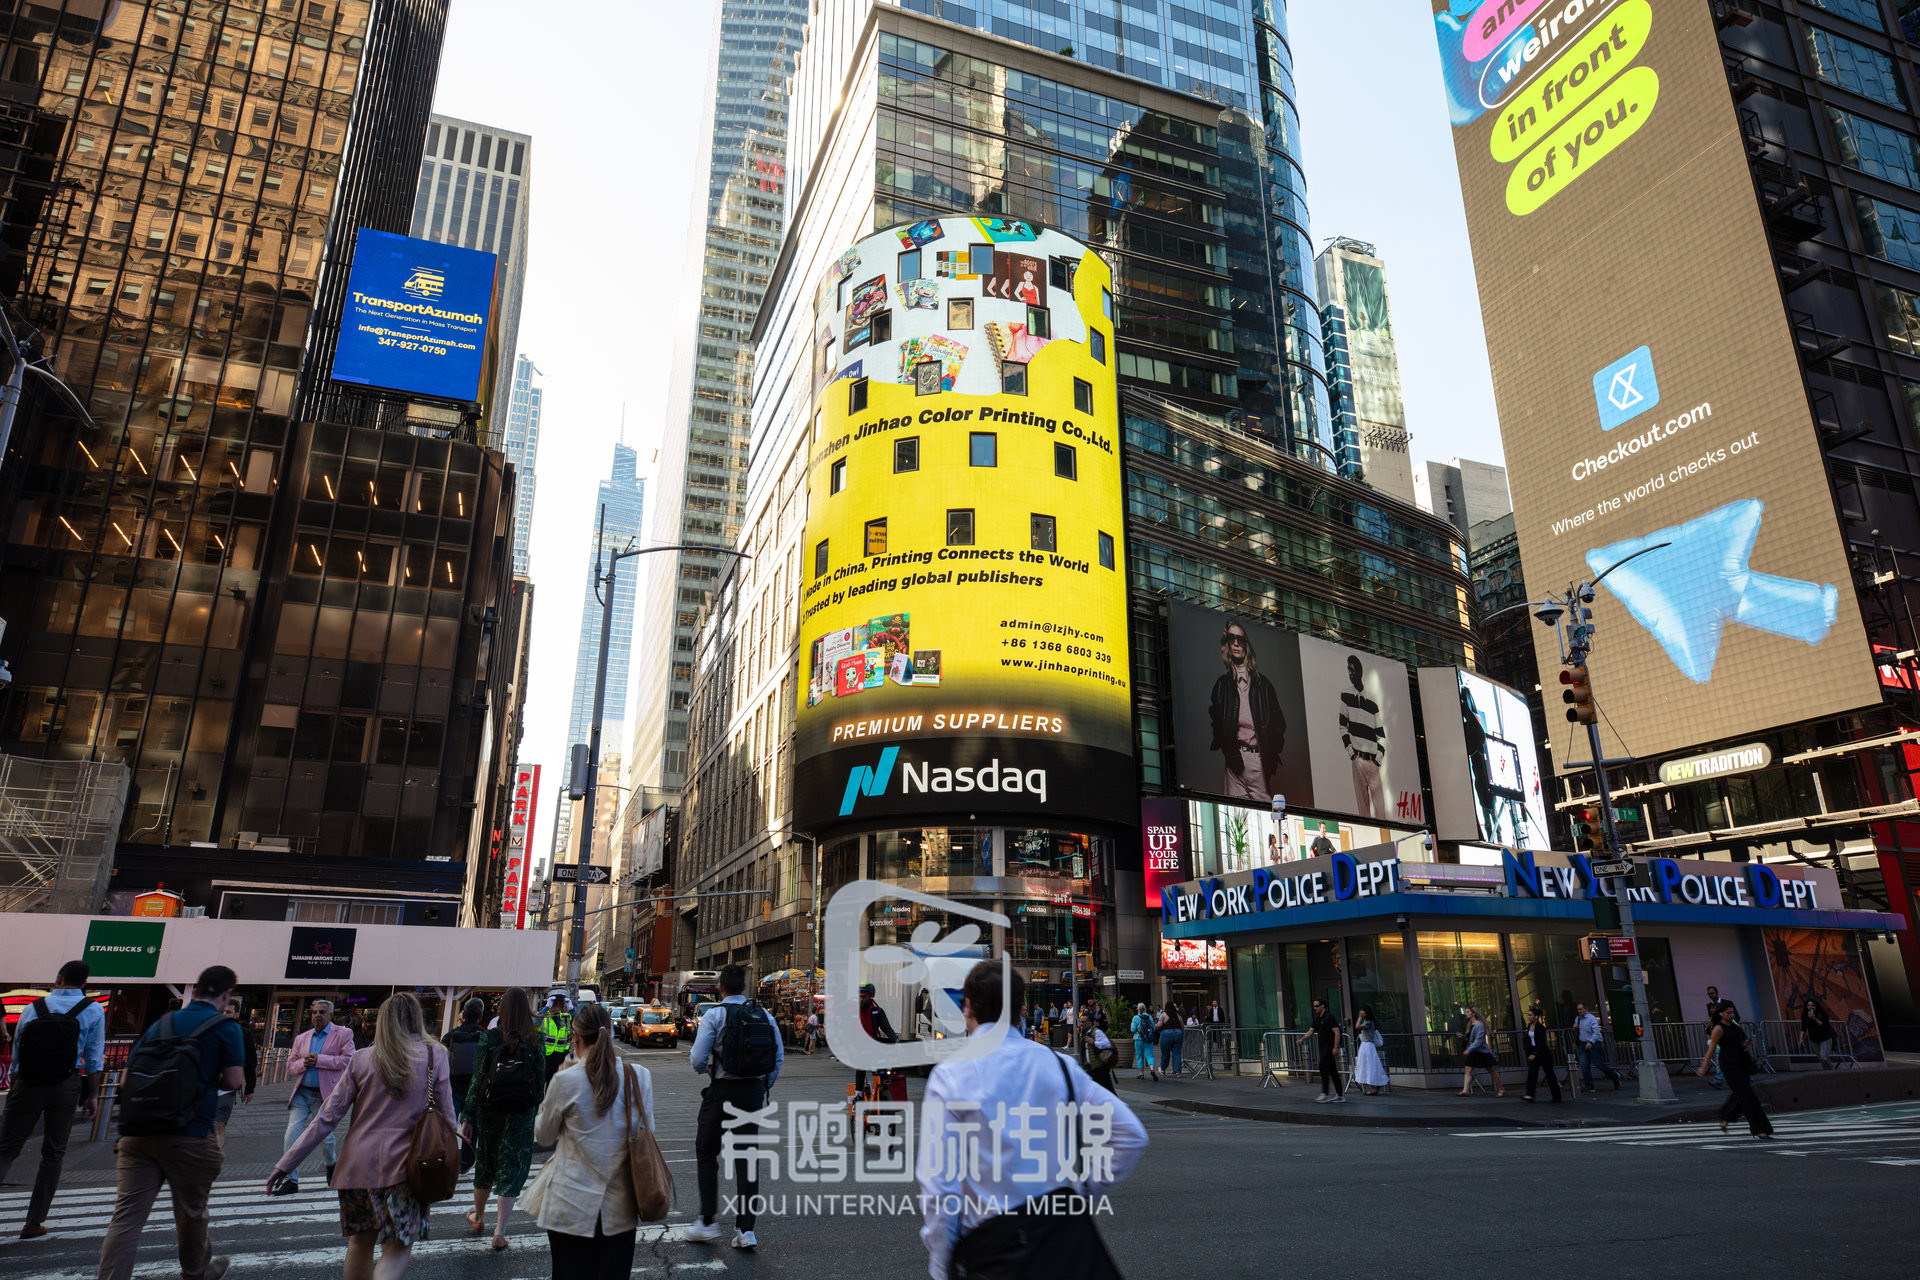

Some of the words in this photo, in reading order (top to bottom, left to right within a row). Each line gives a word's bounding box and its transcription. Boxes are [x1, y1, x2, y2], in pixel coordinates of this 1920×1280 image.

[1482, 0, 1524, 40] an
[1507, 106, 1537, 143] in
[1542, 22, 1628, 112] front
[1527, 146, 1556, 192] of
[1564, 98, 1639, 170] you.
[352, 292, 482, 325] TransportAzumah
[368, 309, 384, 317] Next
[384, 312, 421, 323] Generation
[428, 320, 446, 328] Mass
[446, 322, 477, 333] Transport
[378, 337, 447, 356] 347-927-0750
[854, 415, 912, 441] Jinhao
[918, 407, 973, 425] Color
[979, 407, 1057, 433] Printing
[1061, 420, 1113, 455] Co.,Ltd.
[1571, 401, 1713, 481] Checkout.com
[1551, 507, 1595, 536] Where
[1597, 496, 1621, 516] the
[1623, 473, 1665, 503] world
[1668, 448, 1727, 483] checks
[1730, 431, 1760, 455] out
[823, 575, 832, 587] in
[833, 563, 868, 582] China,
[871, 550, 933, 569] Printing
[937, 548, 1014, 560] Connects
[1019, 550, 1044, 564] the
[1048, 554, 1089, 574] World
[832, 591, 846, 605] by
[848, 578, 897, 598] leading
[901, 570, 953, 590] global
[956, 570, 1043, 587] publishers
[1000, 619, 1104, 643] admin@lzjhy.com
[1001, 638, 1027, 648] +86
[1032, 640, 1062, 652] 1368
[1066, 645, 1092, 658] 6803
[1095, 652, 1112, 664] 339
[1001, 658, 1126, 688] www.jinhaoprinting.eu
[833, 715, 923, 743] PREMIUM
[933, 713, 1064, 734] SUPPLIERS
[902, 758, 1047, 804] Nasdaq
[513, 772, 531, 825] PARK
[1397, 790, 1421, 822] H&M
[1147, 826, 1176, 834] SPAIN
[1147, 834, 1177, 850] UP
[1149, 850, 1178, 859] YOUR
[1149, 859, 1179, 869] LIFE
[1614, 863, 1628, 871] WAY
[503, 858, 521, 913] PARK
[1161, 885, 1201, 924] NEW
[1198, 878, 1251, 919] YORK
[1253, 868, 1327, 912] POLICE
[1331, 853, 1398, 901] DEPT
[1503, 849, 1576, 899] NEW
[1656, 859, 1750, 907] POLICE
[1752, 863, 1818, 910] DEPT
[1026, 906, 1047, 914] Nasdaq
[89, 945, 142, 953] STARBUCKS
